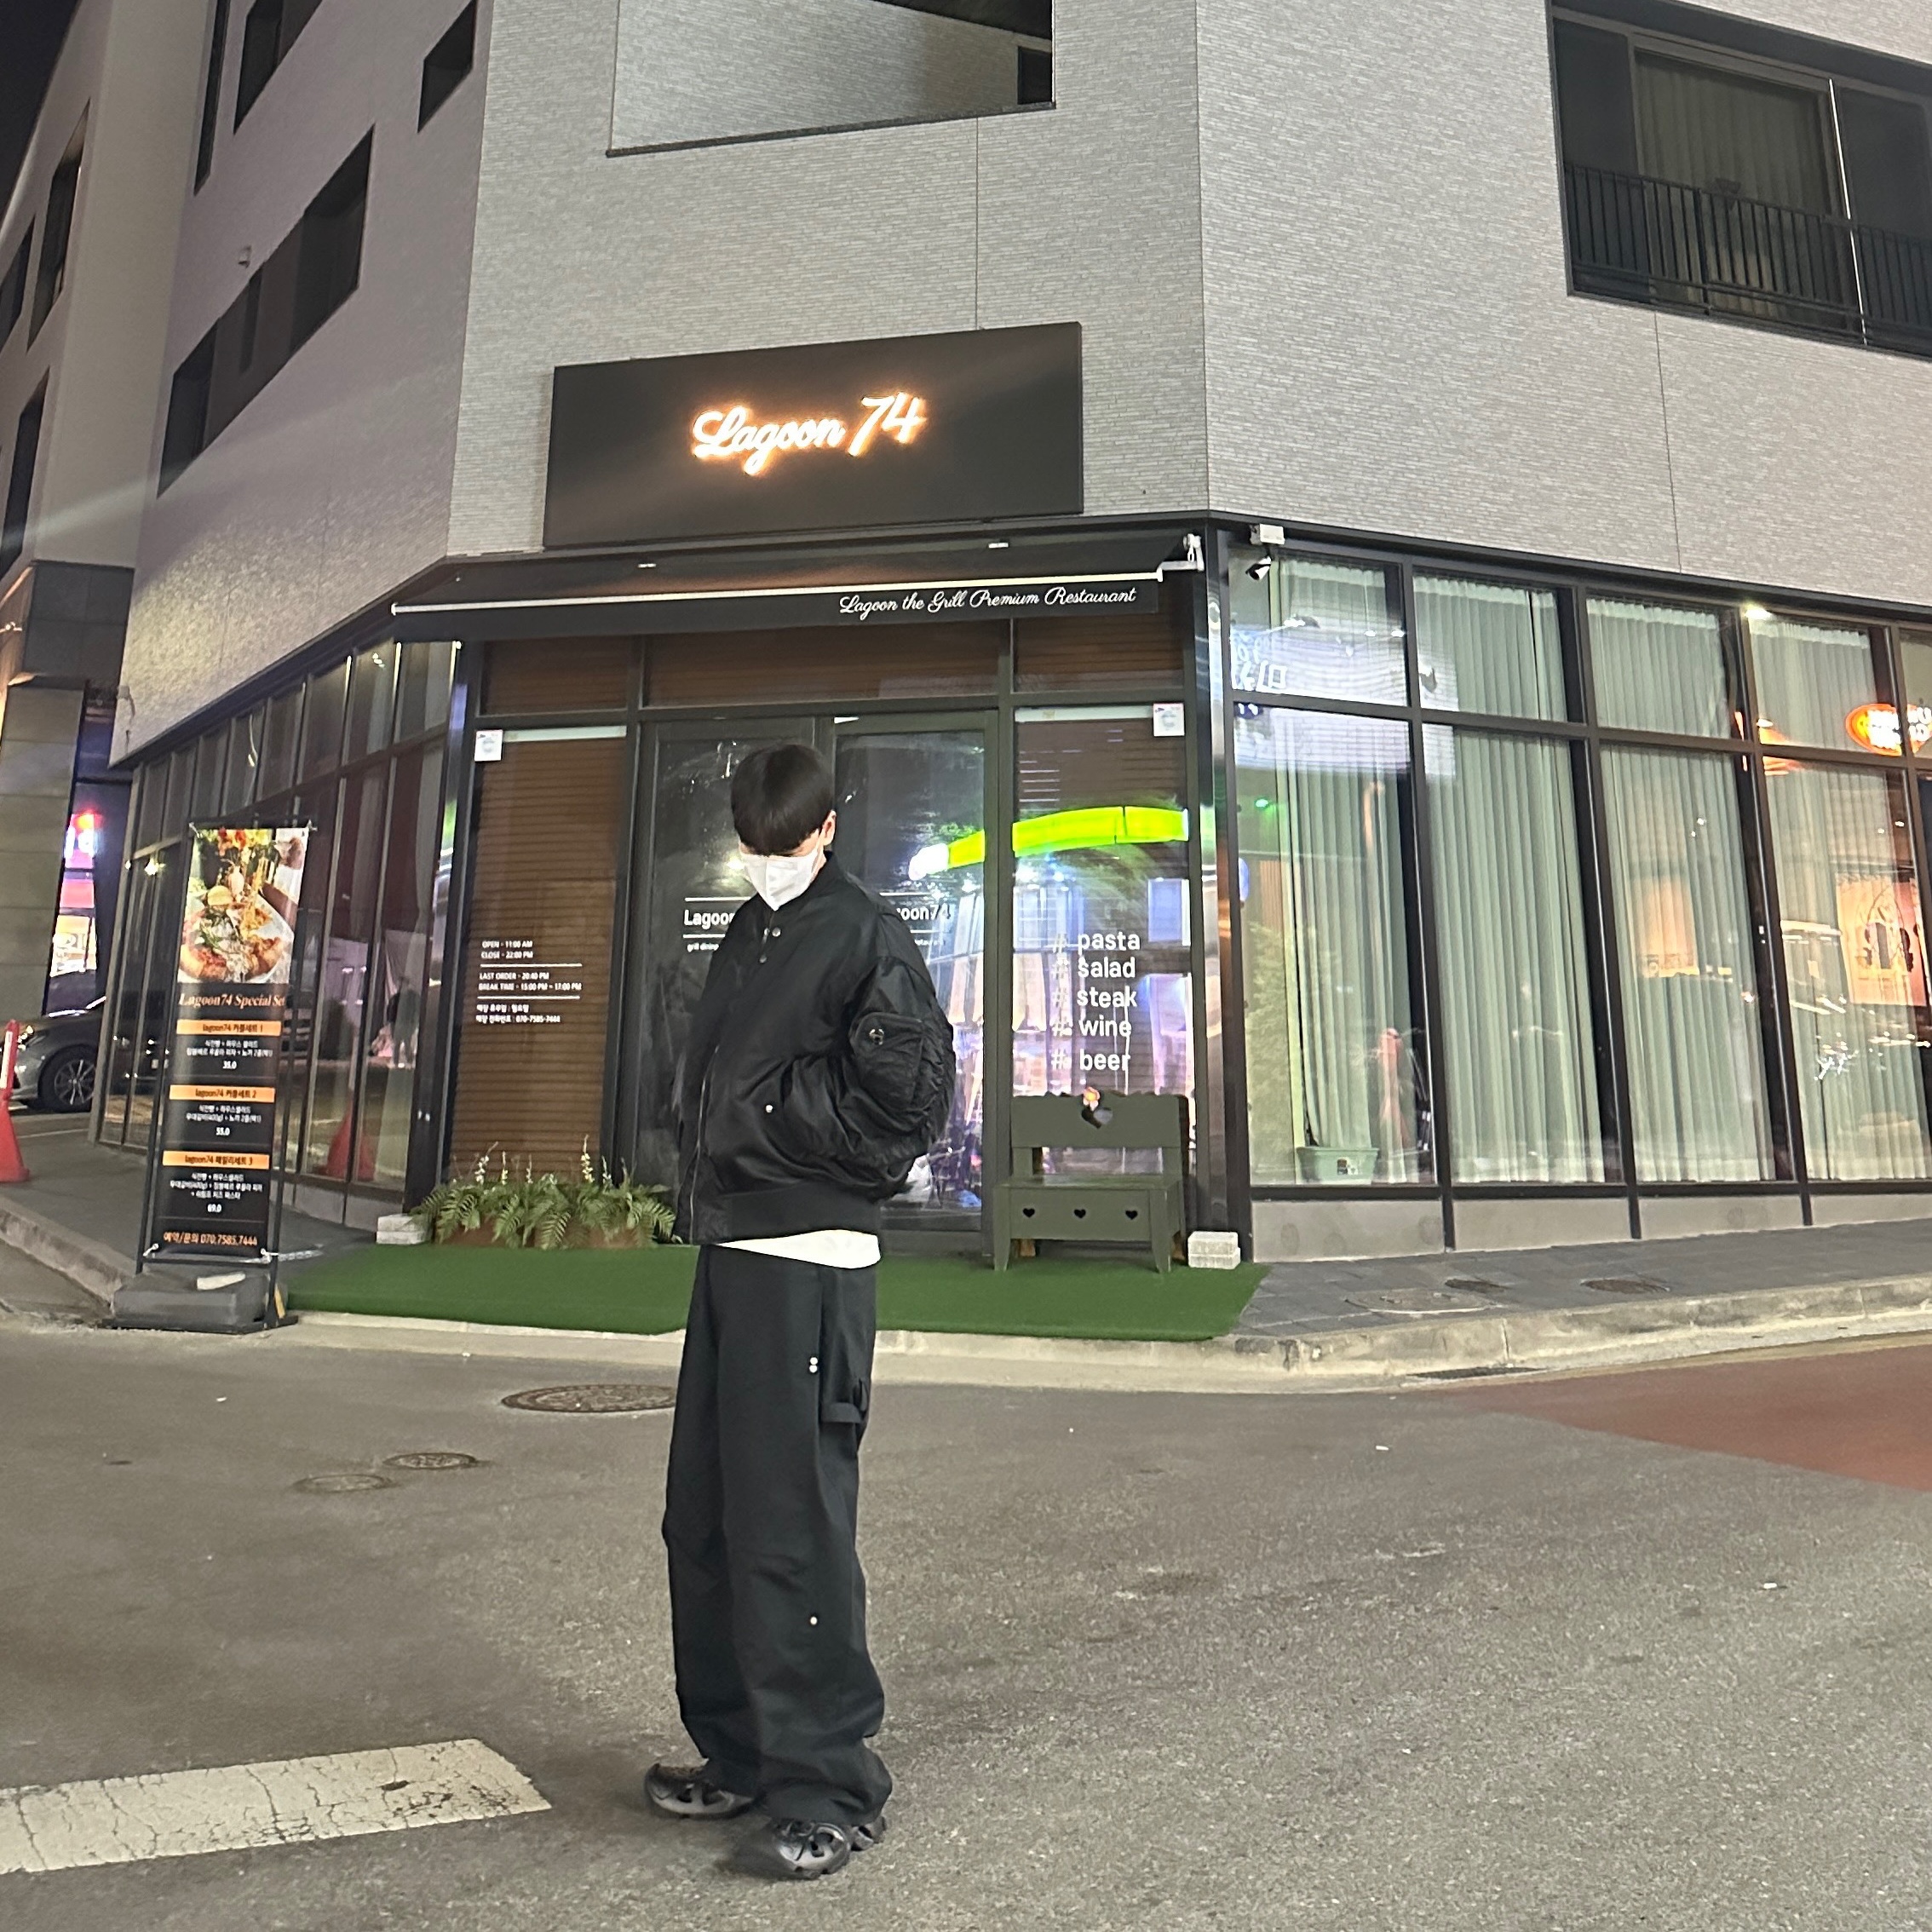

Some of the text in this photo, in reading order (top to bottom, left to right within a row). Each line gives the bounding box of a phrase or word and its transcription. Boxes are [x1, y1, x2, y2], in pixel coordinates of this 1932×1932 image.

[692, 390, 927, 475] Lagoon 74
[839, 586, 1136, 621] Lagoon the Grill Premium Restaurant
[896, 903, 952, 920] oon74
[1078, 931, 1141, 955] pasta
[1078, 957, 1136, 978] salad
[234, 992, 272, 1009] Special
[1077, 986, 1138, 1008] steak
[1078, 1015, 1132, 1037] wine
[1079, 1049, 1131, 1070] beer
